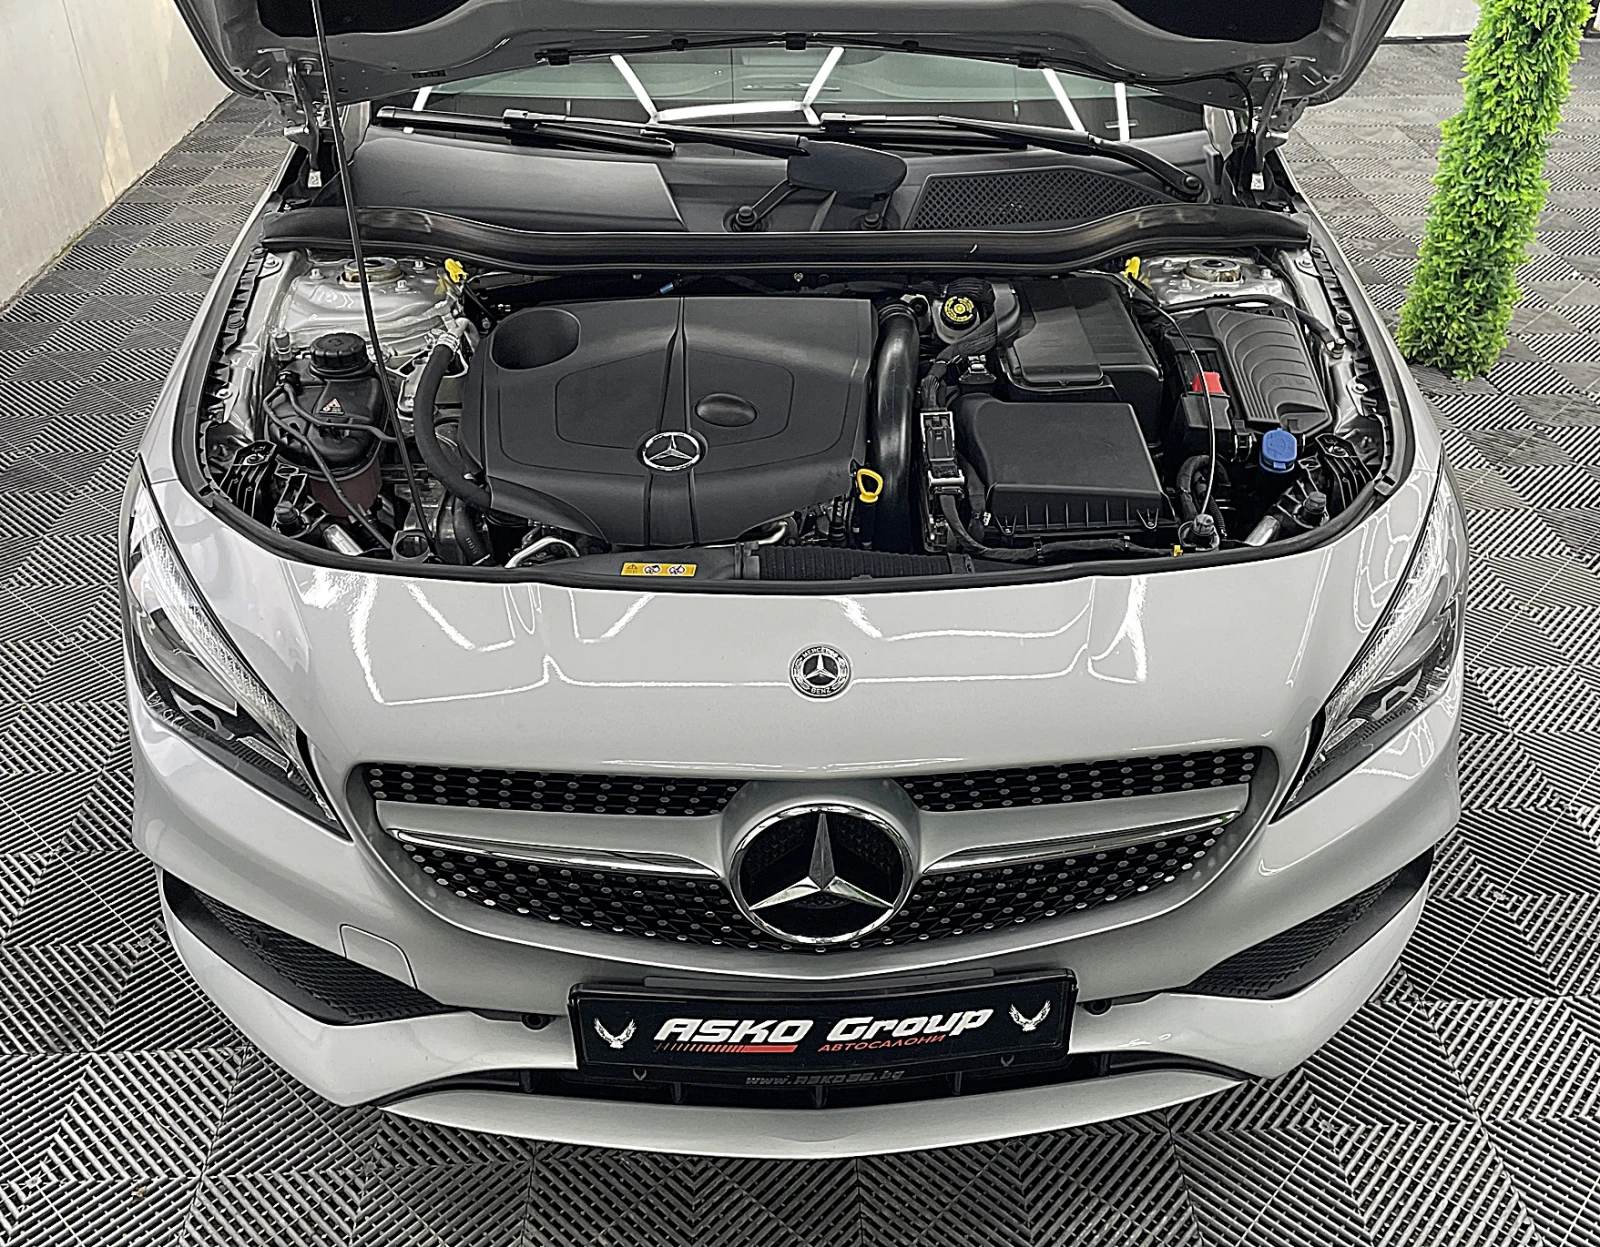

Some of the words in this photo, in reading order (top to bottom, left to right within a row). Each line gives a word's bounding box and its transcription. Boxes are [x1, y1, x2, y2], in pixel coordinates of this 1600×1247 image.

[653, 1018, 814, 1043] ASKO
[826, 1008, 994, 1041] Group
[817, 1034, 947, 1052] АВТОСАЛОНИ
